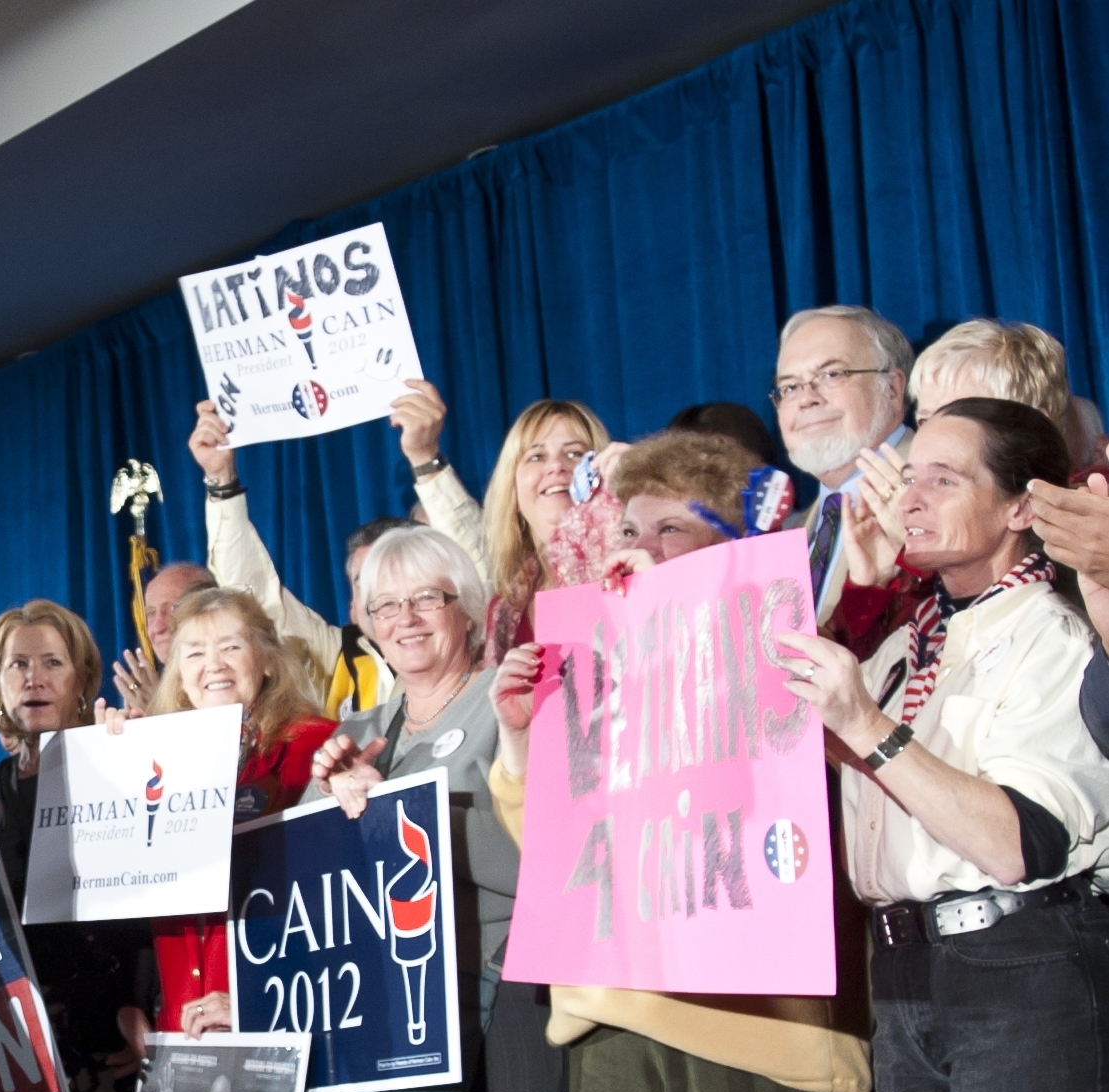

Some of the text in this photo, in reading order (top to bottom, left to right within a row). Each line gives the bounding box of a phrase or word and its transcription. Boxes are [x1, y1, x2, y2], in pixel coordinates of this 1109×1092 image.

[201, 297, 397, 364] HERMAN CAIN
[236, 332, 368, 377] President 2012
[38, 786, 229, 829] HERMAN CAIN
[73, 817, 198, 844] President 2012
[72, 870, 178, 891] HermanCain.com
[238, 860, 386, 965] CAIN
[263, 961, 364, 1034] 2012
